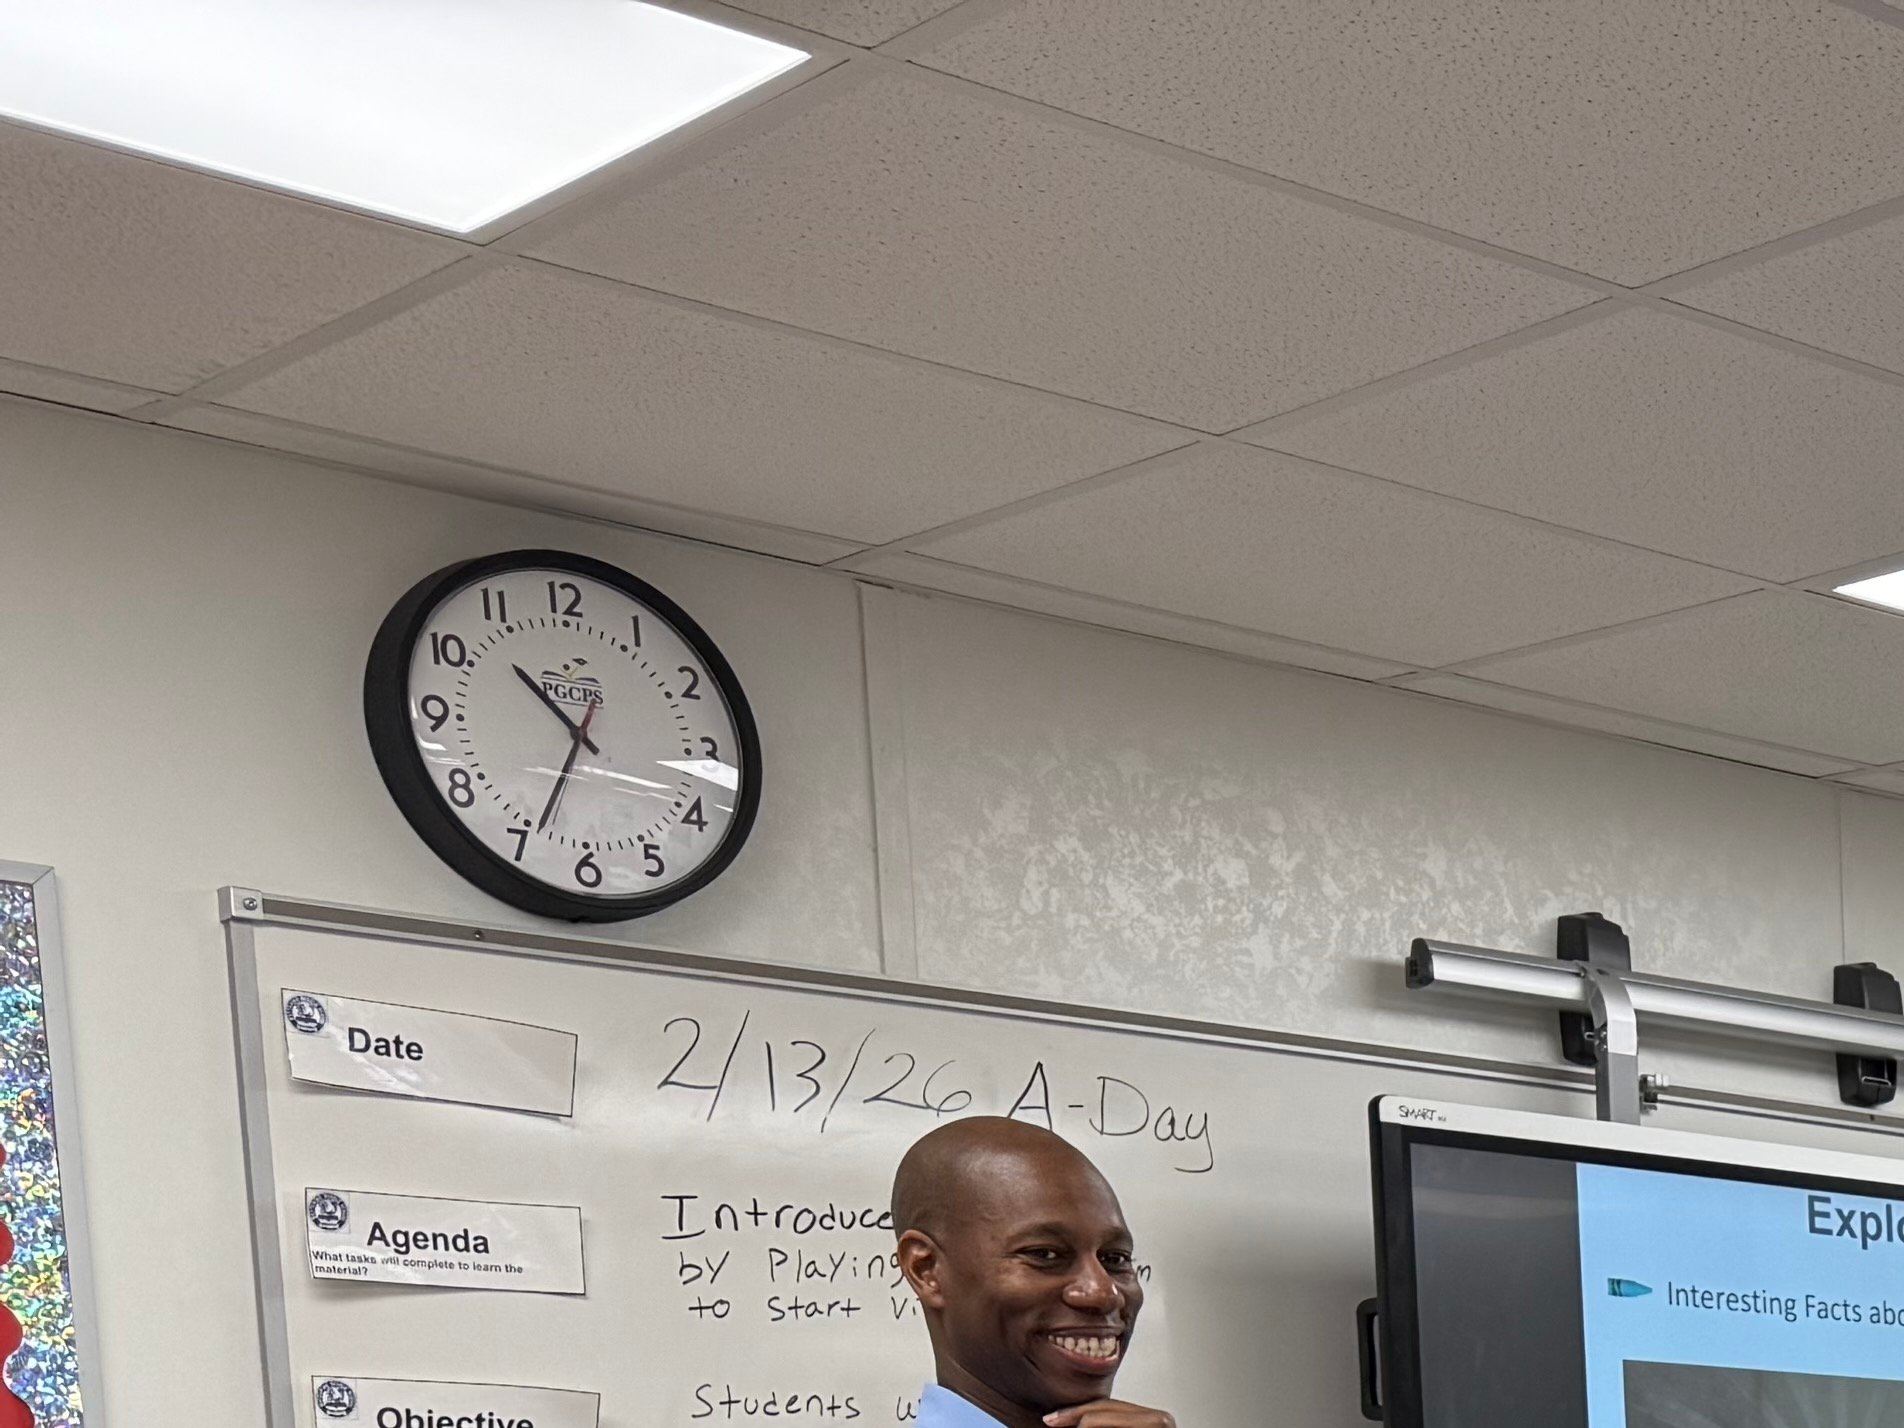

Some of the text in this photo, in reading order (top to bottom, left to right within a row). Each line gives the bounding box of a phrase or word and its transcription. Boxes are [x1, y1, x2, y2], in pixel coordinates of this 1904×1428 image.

[480, 587, 507, 623] 11
[547, 580, 583, 619] 12
[630, 615, 641, 648] 1
[430, 631, 467, 668] 10
[541, 681, 604, 705] PGCPS
[677, 666, 701, 701] 2
[420, 694, 449, 733] 9
[699, 736, 719, 775] 3
[448, 768, 475, 809] 8
[681, 796, 708, 833] 4
[506, 828, 529, 862] 7
[644, 843, 665, 878] 5
[574, 850, 602, 888] 6
[347, 1027, 424, 1061] Date
[657, 1010, 1214, 1173] 2/13/26 A-Day
[1399, 1105, 1437, 1121] SMART
[366, 1222, 490, 1255] Agenda
[312, 1250, 343, 1262] What
[346, 1253, 377, 1264] tasks
[403, 1258, 454, 1271] complete
[458, 1261, 469, 1270] to
[473, 1261, 501, 1272] learn
[505, 1263, 523, 1274] the
[315, 1266, 368, 1276] material?
[679, 1250, 730, 1285] by
[688, 1296, 730, 1319] to
[1668, 1281, 1797, 1322] Interesting
[1805, 1294, 1862, 1323] Facts
[692, 1384, 860, 1419] Students
